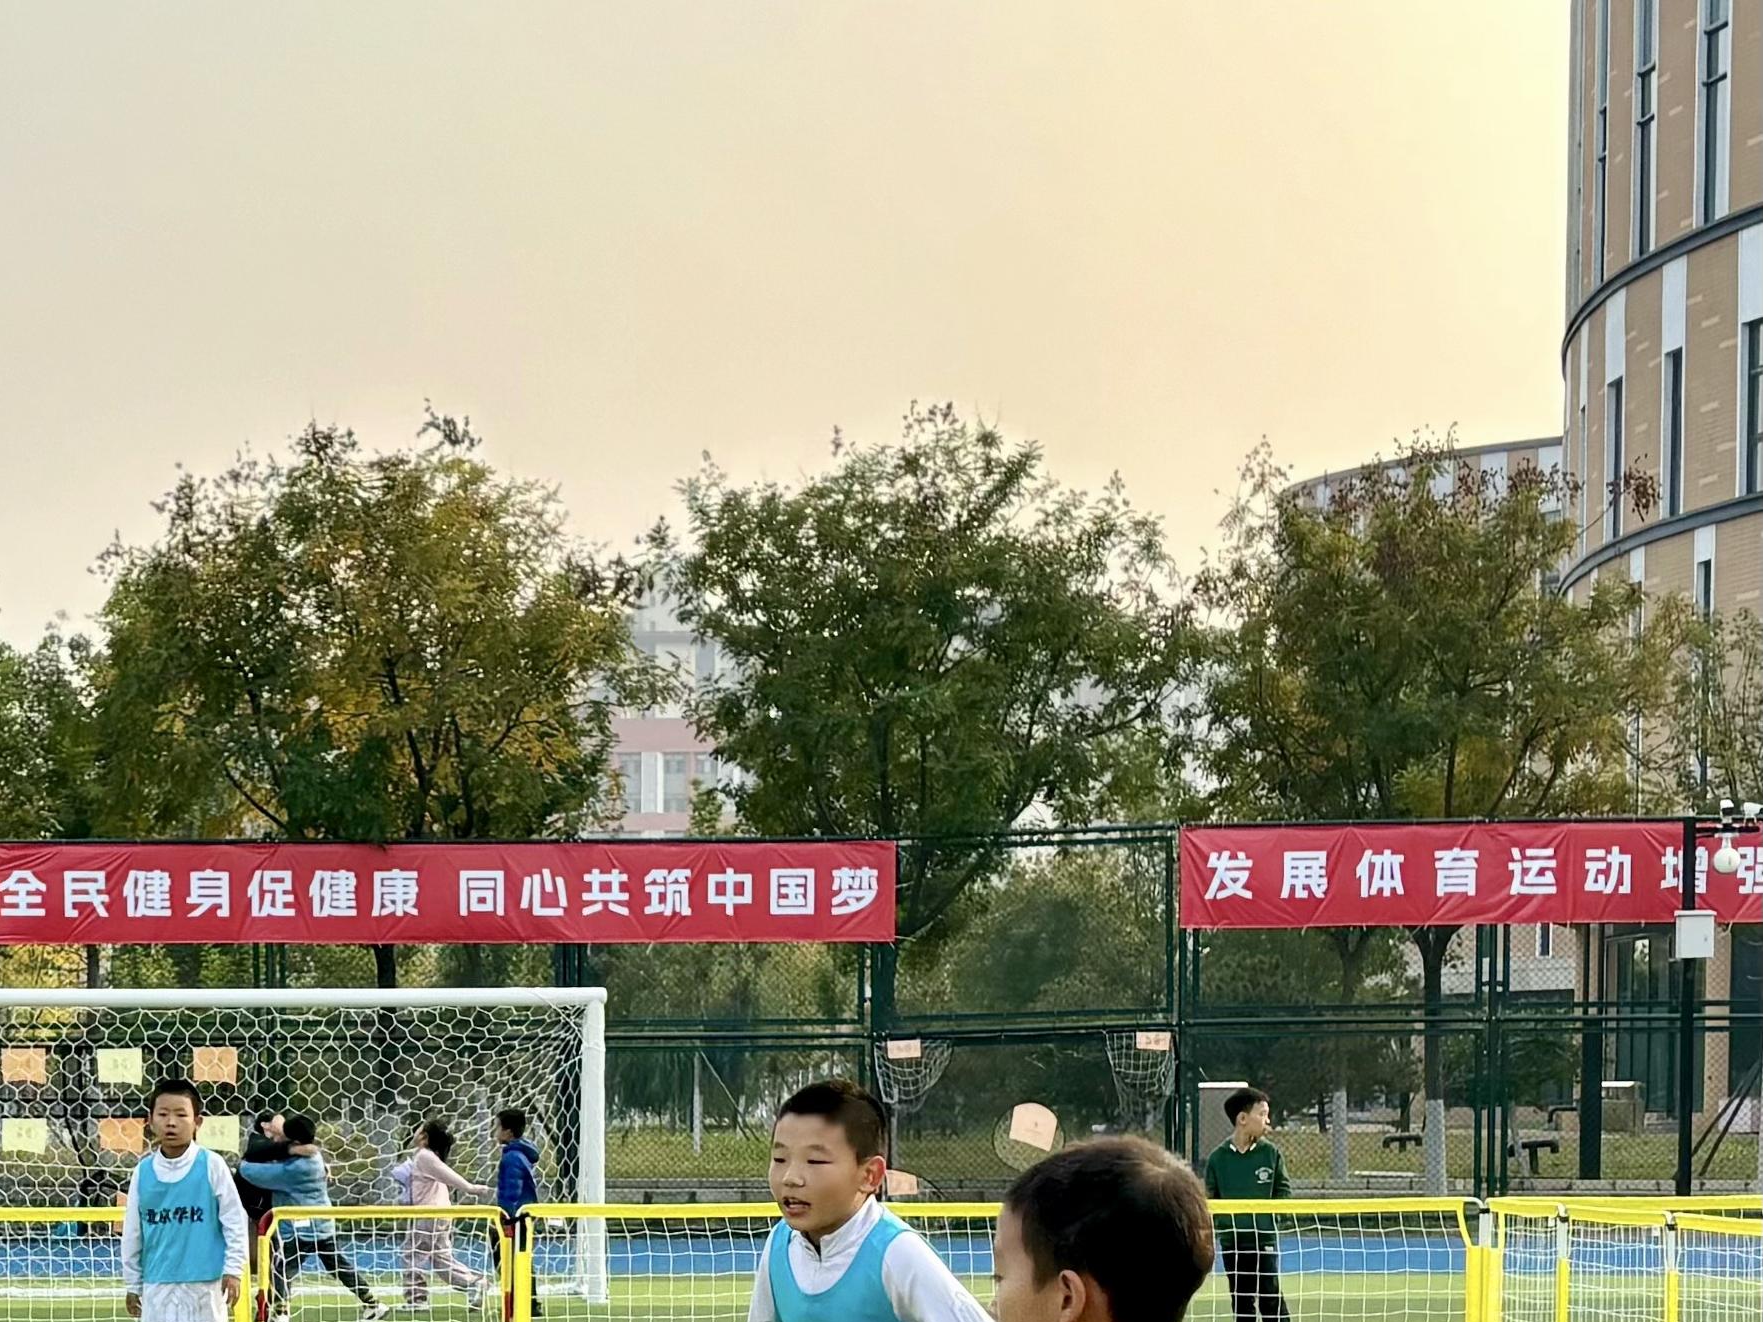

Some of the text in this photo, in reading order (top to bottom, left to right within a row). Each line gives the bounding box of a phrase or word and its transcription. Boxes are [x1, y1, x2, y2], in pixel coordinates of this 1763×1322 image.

[459, 866, 880, 917] 同心共筑中国梦
